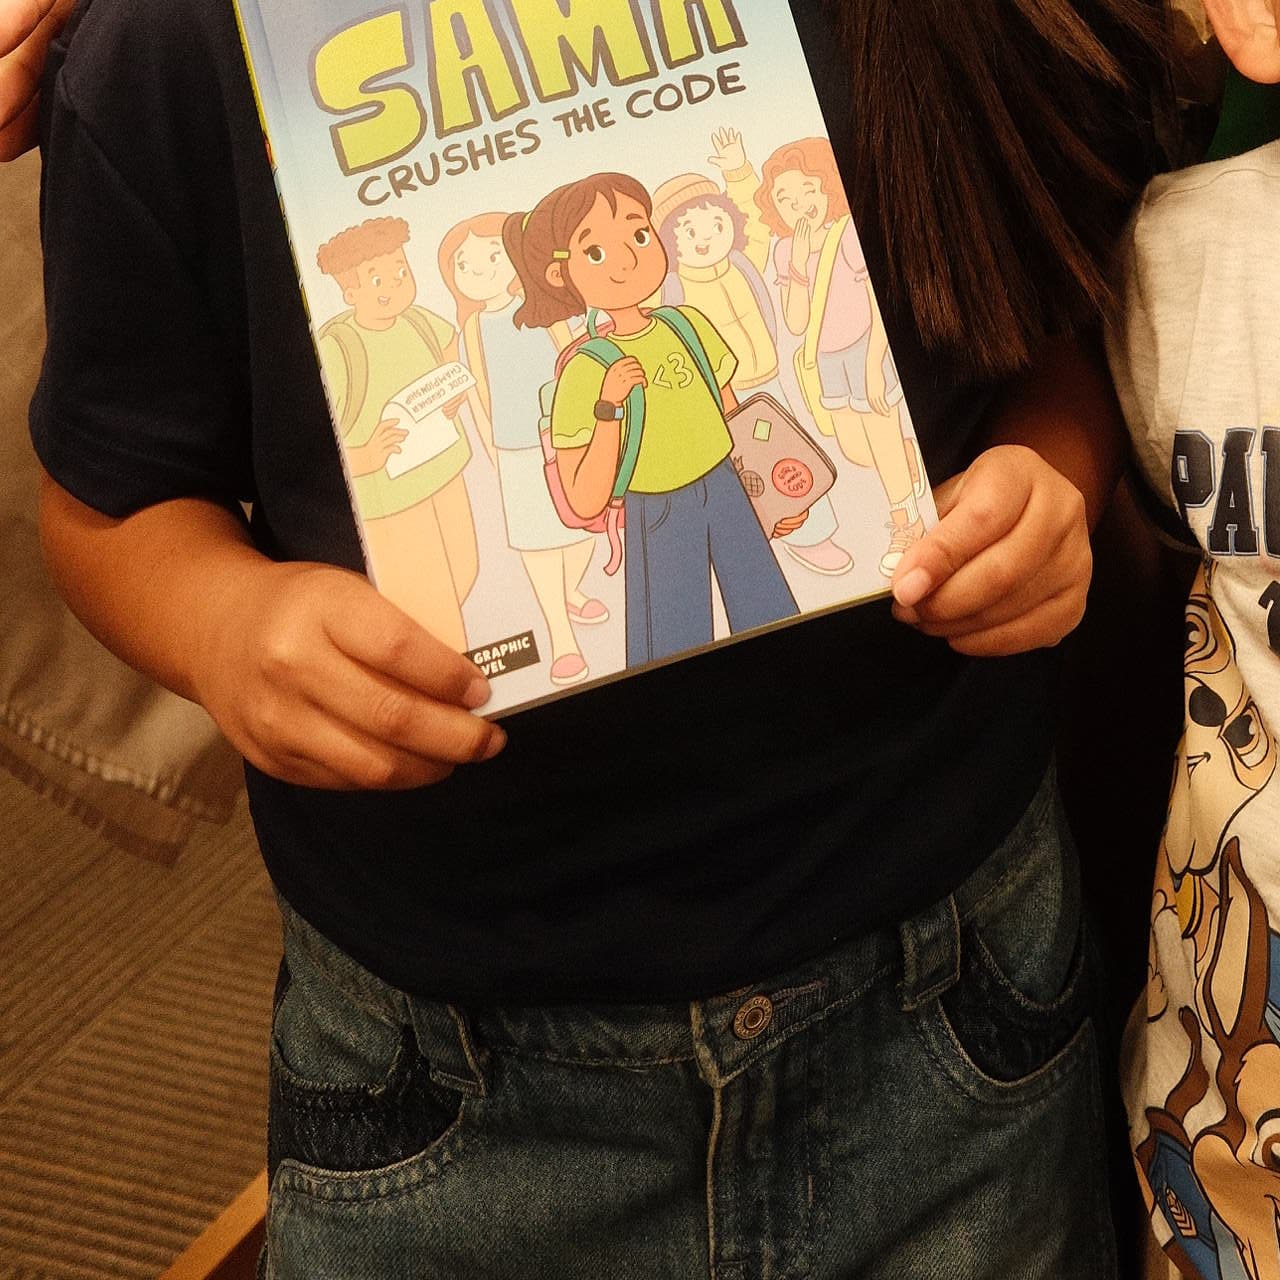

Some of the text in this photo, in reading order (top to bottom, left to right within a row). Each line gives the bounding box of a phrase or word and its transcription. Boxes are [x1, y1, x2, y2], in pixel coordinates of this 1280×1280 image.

[357, 62, 747, 206] CRUSHES THE CODE
[405, 364, 462, 405] CHAMPIONSHIP
[473, 636, 531, 665] GRAPHIC
[480, 659, 506, 676] VEL
